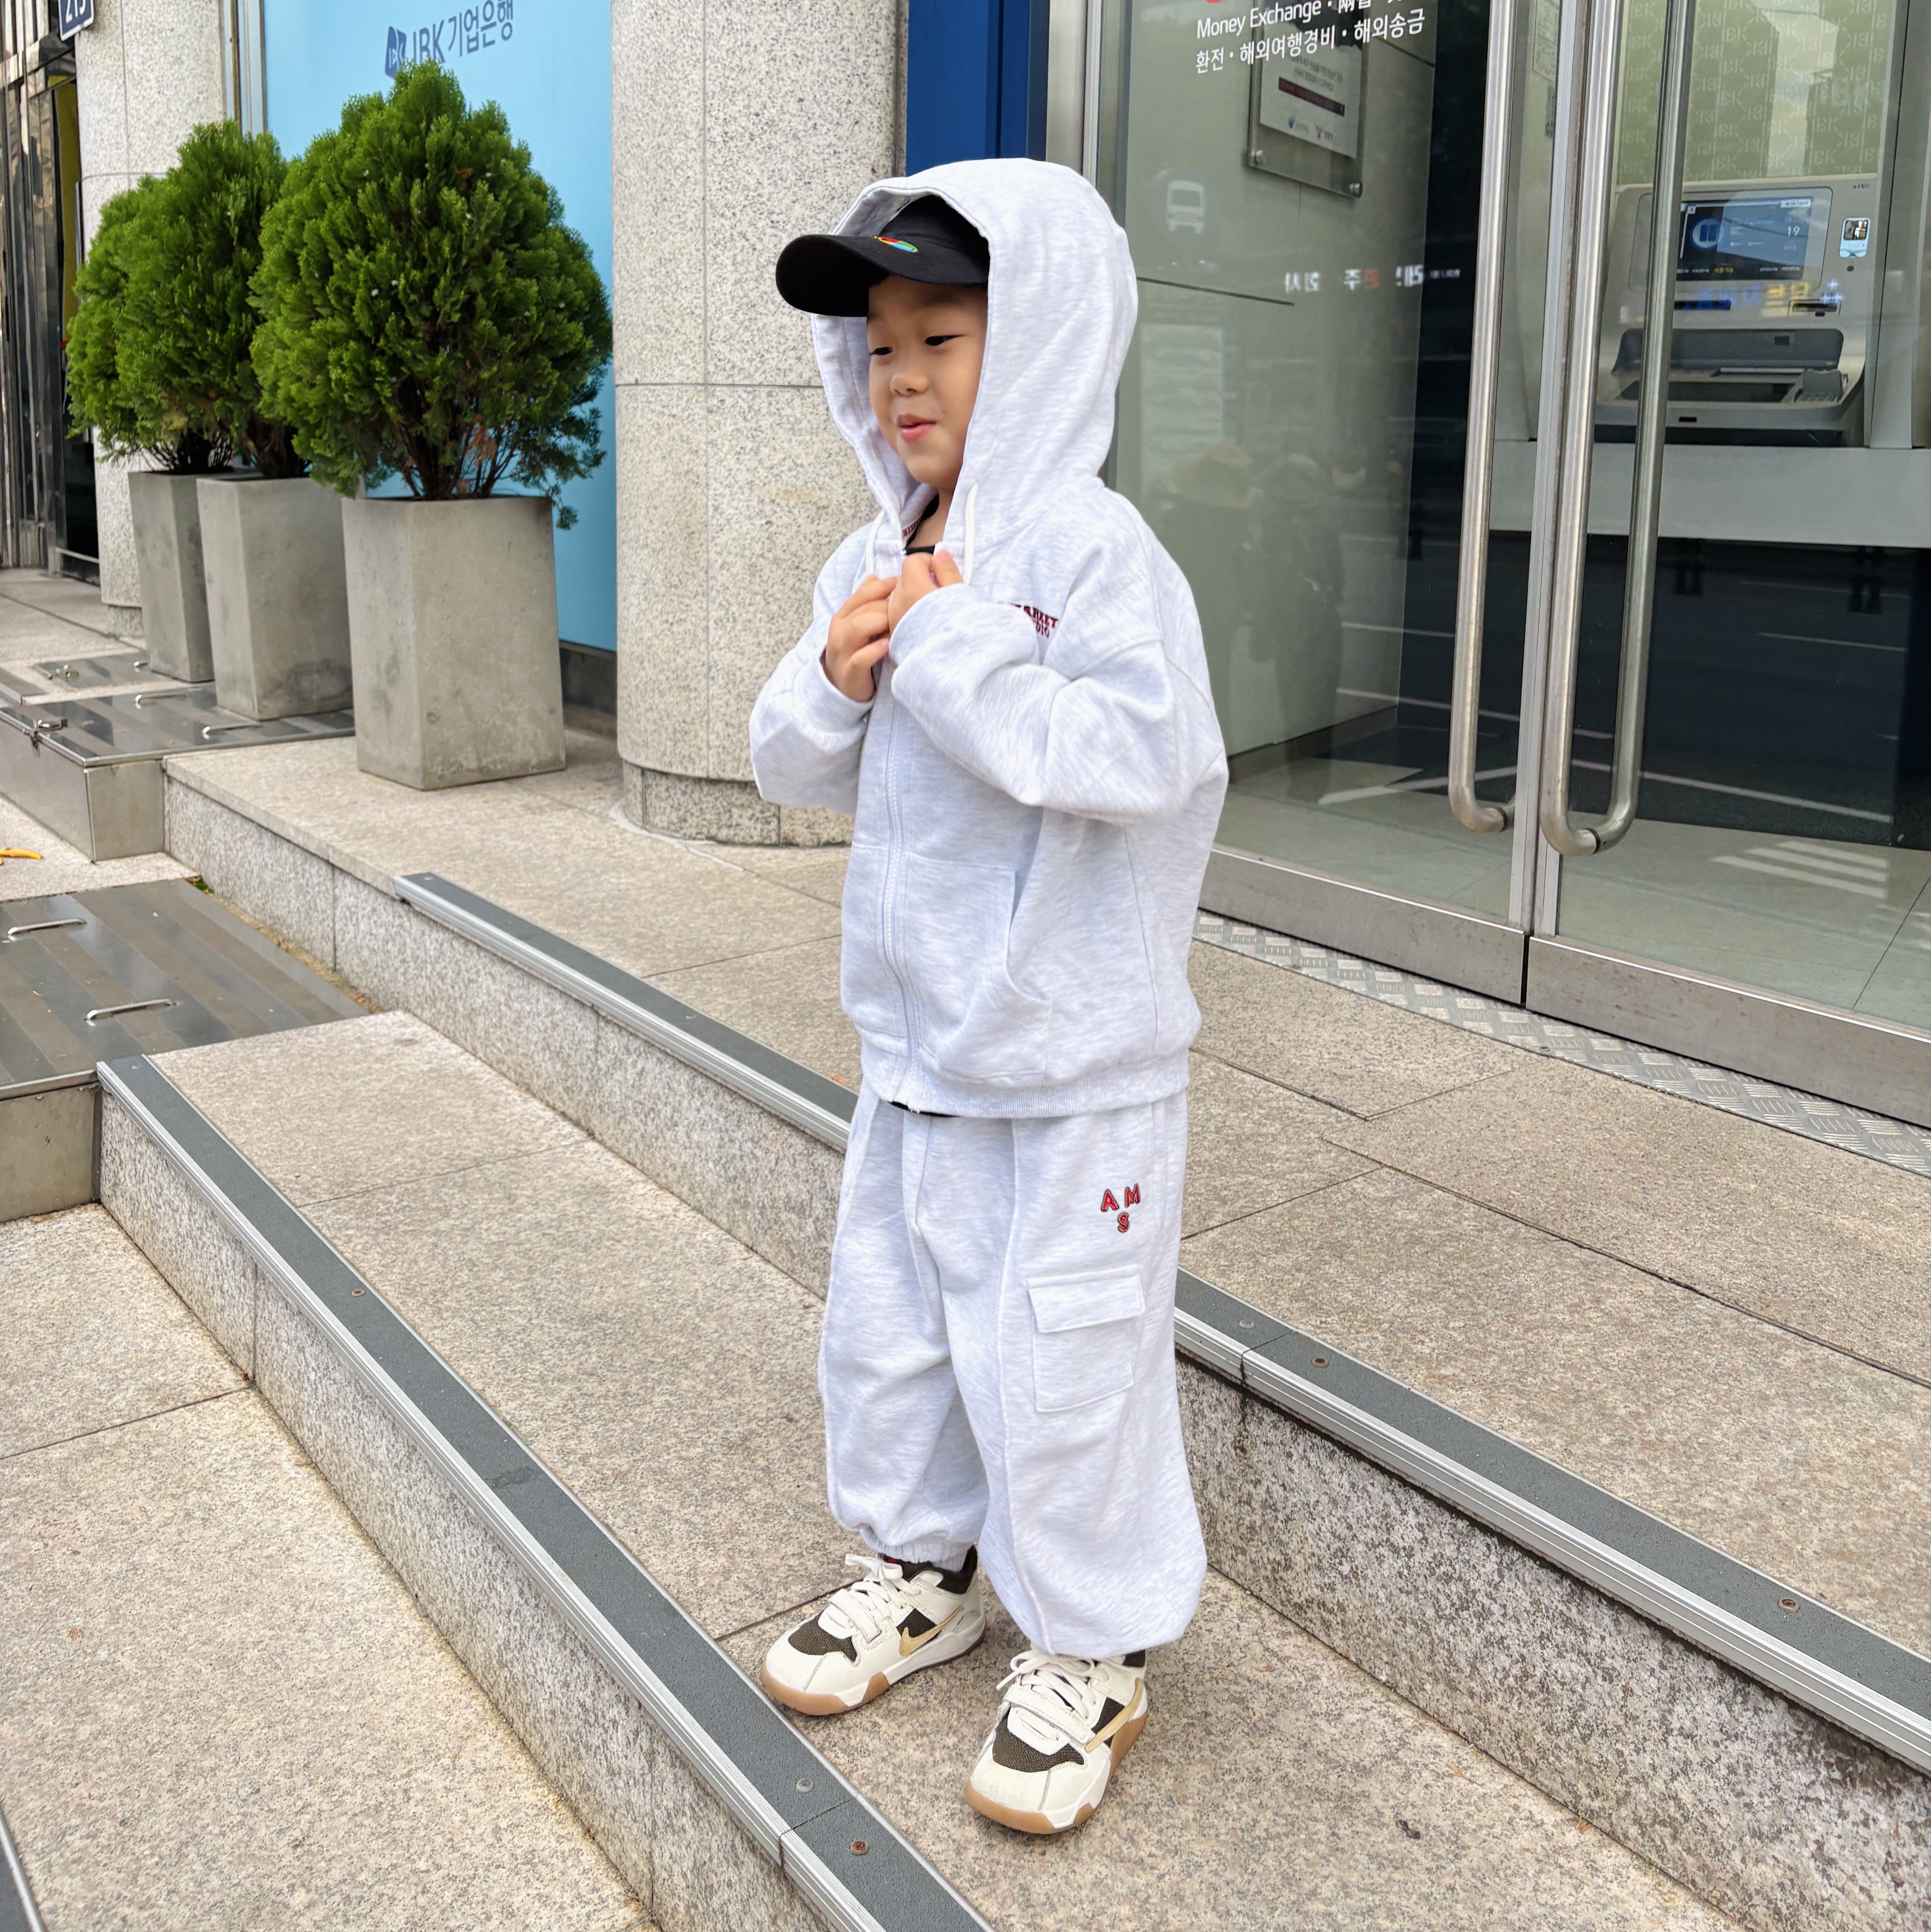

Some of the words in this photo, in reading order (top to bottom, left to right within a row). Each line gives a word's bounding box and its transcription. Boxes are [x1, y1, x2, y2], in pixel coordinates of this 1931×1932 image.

[1197, 15, 1246, 39] Money
[1250, 0, 1321, 28] Exchange
[1195, 46, 1225, 74] 환전
[1239, 24, 1336, 64] 해외여행경비
[1354, 8, 1425, 43] 해외송금
[1787, 225, 1800, 237] 19
[1117, 1212, 1129, 1233] S
